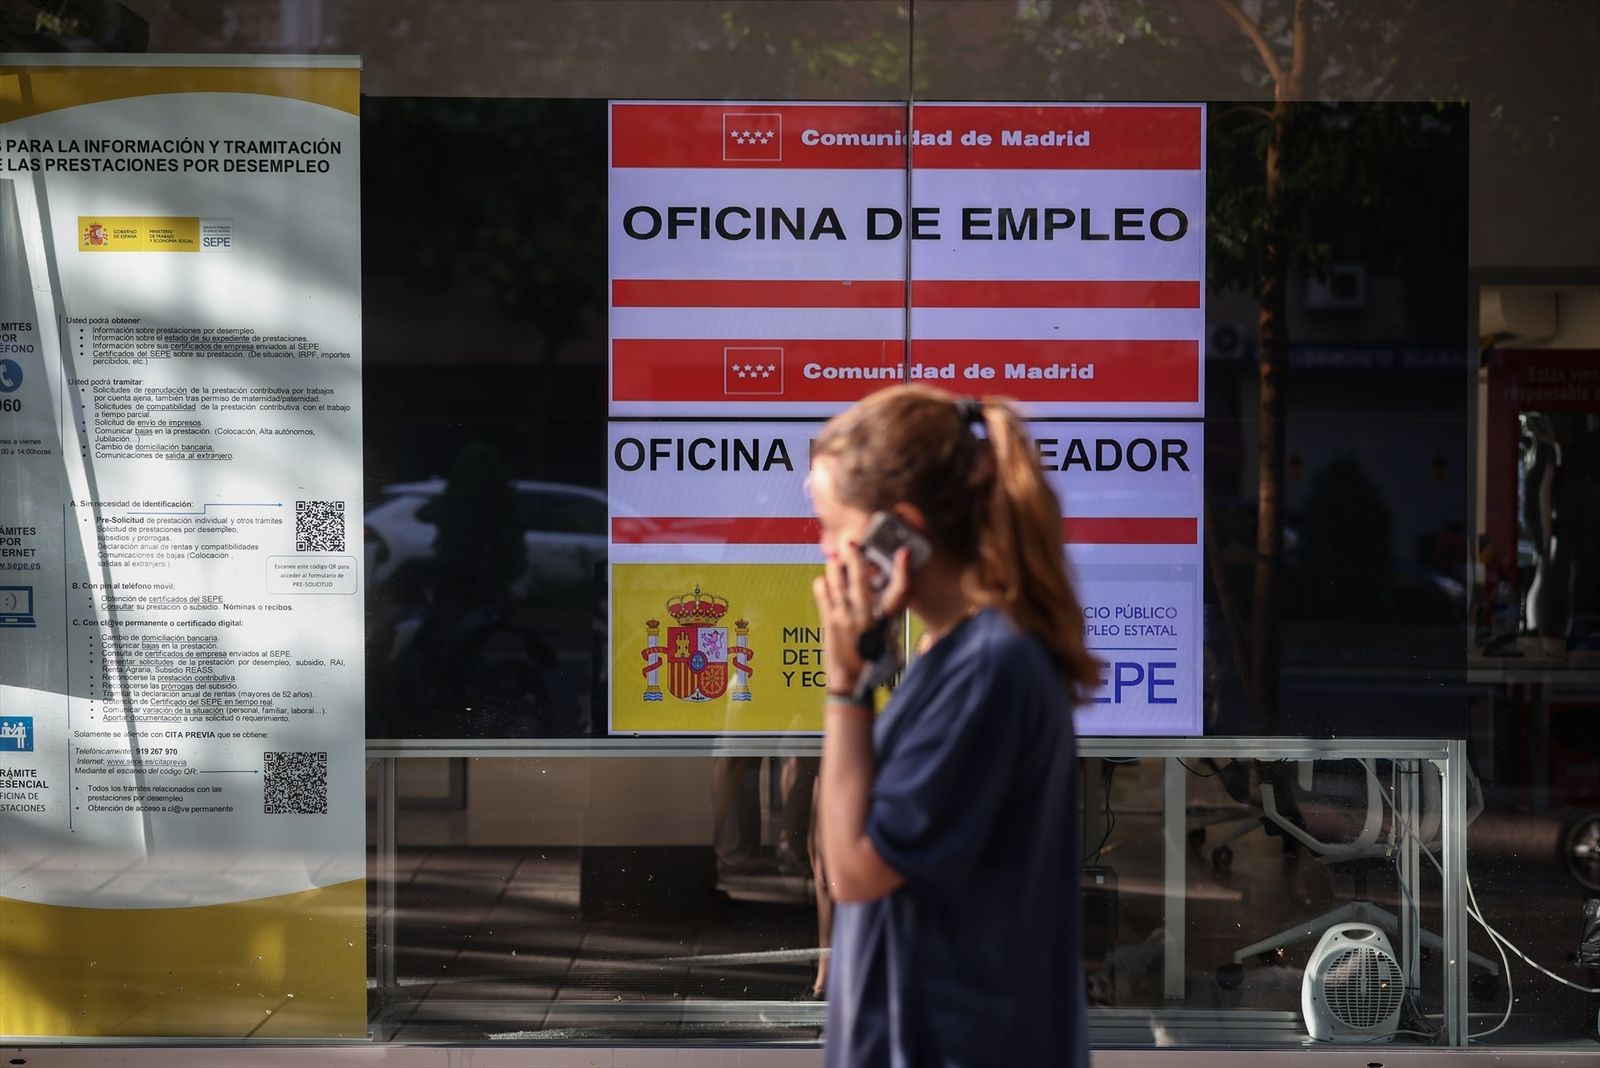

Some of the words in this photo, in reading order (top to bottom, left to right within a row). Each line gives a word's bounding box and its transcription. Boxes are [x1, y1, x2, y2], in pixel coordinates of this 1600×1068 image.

[801, 129, 952, 146] Comunidad
[961, 130, 992, 146] de
[1001, 130, 1090, 146] Madrid
[6, 140, 54, 152] PARA
[58, 140, 80, 153] LA
[84, 136, 205, 154] INFORMACIÓN
[208, 140, 219, 154] Y
[224, 138, 341, 155] TRAMITACIÓN
[8, 158, 40, 171] LAS
[46, 158, 178, 172] PRESTACIONES
[184, 159, 219, 173] POR
[224, 159, 330, 173] DESEMPLEO
[622, 205, 846, 241] OFICINA
[866, 208, 941, 240] DE
[962, 206, 1188, 242] EMPLEO
[203, 237, 230, 247] SEPE
[89, 317, 109, 325] podrá
[803, 363, 955, 380] Comunidad
[964, 364, 995, 380] de
[1004, 363, 1094, 380] Madrid
[91, 378, 111, 386] podrá
[0, 399, 21, 412] 60
[147, 404, 196, 412] compatibilidad
[220, 404, 256, 412] prestación
[327, 404, 351, 412] trabajo
[614, 438, 793, 472] OFICINA
[1034, 438, 1190, 472] EADOR
[157, 517, 192, 525] prestación
[0, 538, 21, 546] POR
[1116, 604, 1178, 619] PÚBLICO
[1084, 625, 1120, 636] PLEO
[1124, 625, 1177, 636] ESTATAL
[783, 649, 809, 665] DE
[782, 672, 795, 687] Y
[1088, 662, 1178, 704] EPE
